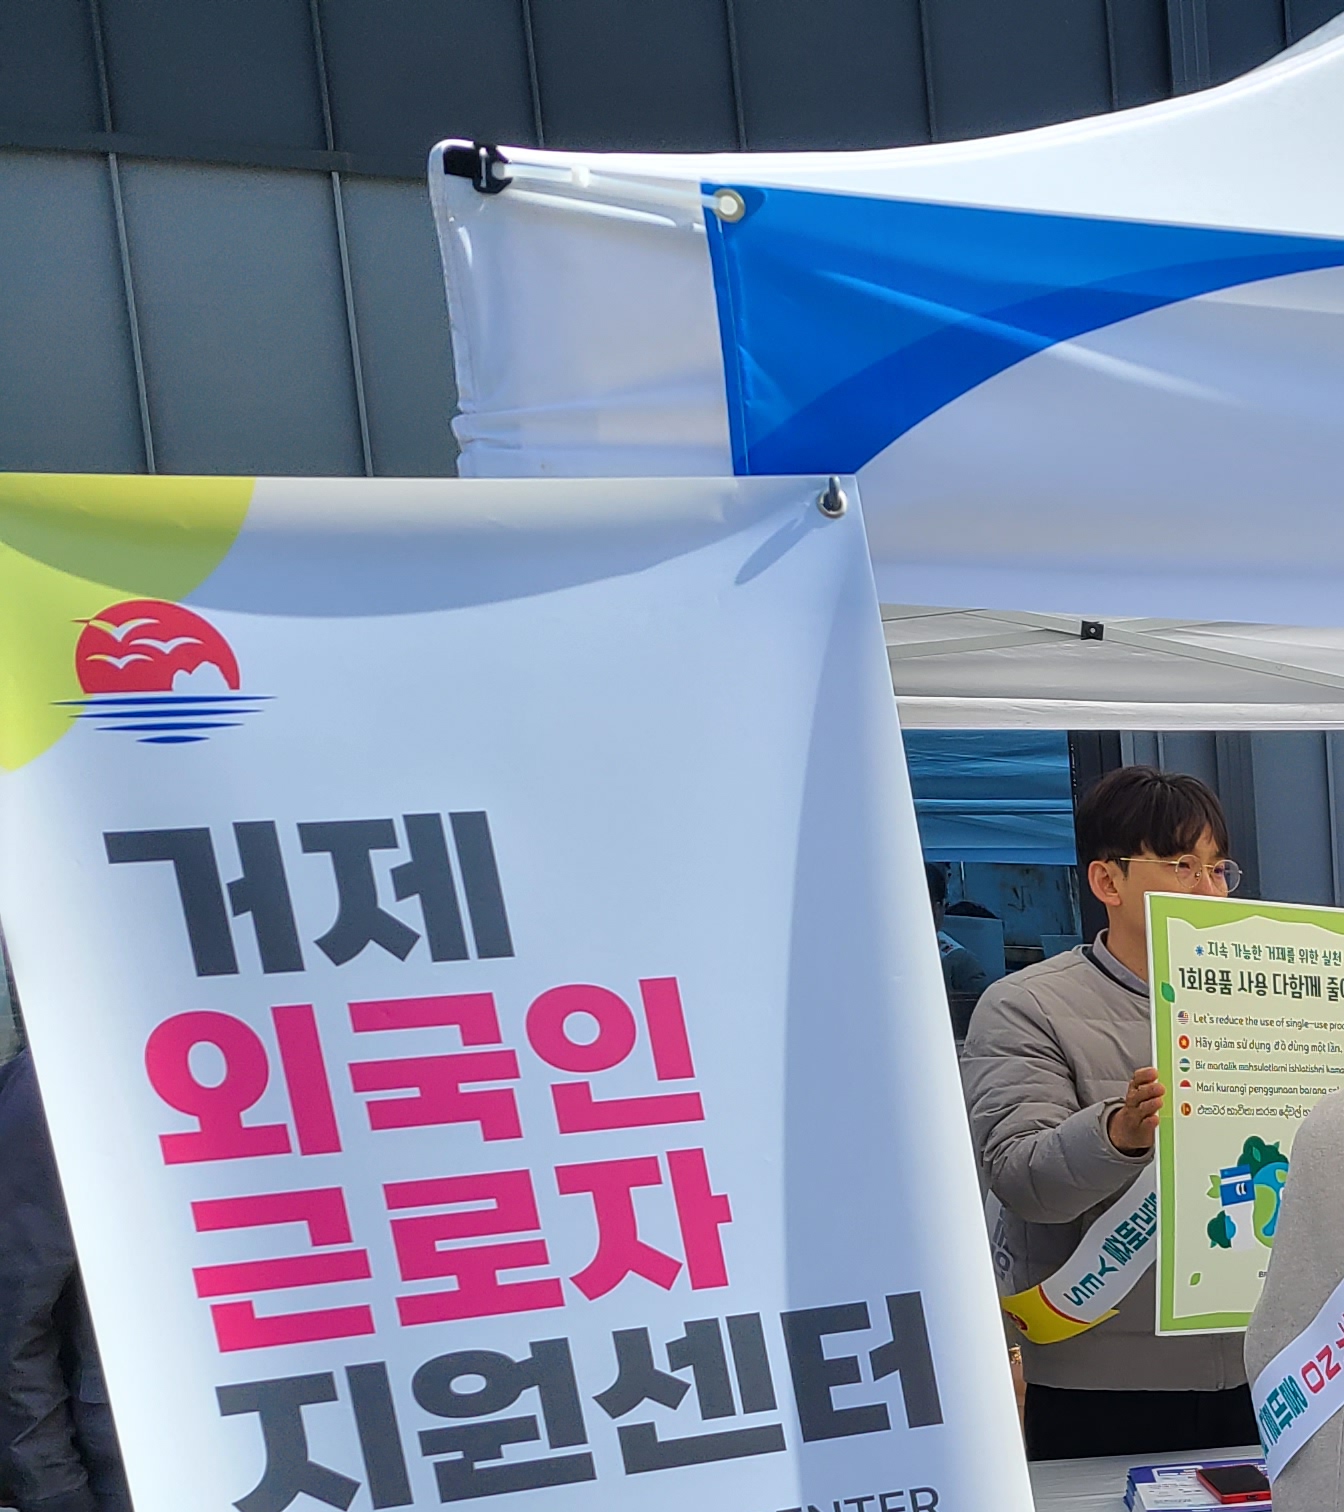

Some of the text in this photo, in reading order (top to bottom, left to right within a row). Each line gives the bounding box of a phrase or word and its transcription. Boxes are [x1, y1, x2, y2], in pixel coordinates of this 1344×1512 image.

[105, 810, 514, 976] 거제
[1208, 941, 1342, 967] 지속 가능한 거제를 위한 실천
[1178, 967, 1233, 996] 1회용품
[1237, 970, 1269, 997] 사용
[1272, 973, 1321, 1000] 다함께
[1193, 1012, 1216, 1024] Let's
[1216, 1014, 1244, 1025] reduce
[1245, 1016, 1258, 1026] the
[1260, 1019, 1274, 1027] use
[1275, 1017, 1285, 1028] of
[144, 977, 704, 1165] 외국인
[1196, 1082, 1214, 1093] Mari
[191, 1148, 731, 1352] 근로자
[1063, 1254, 1120, 1307] YES
[1299, 1344, 1342, 1394] NO
